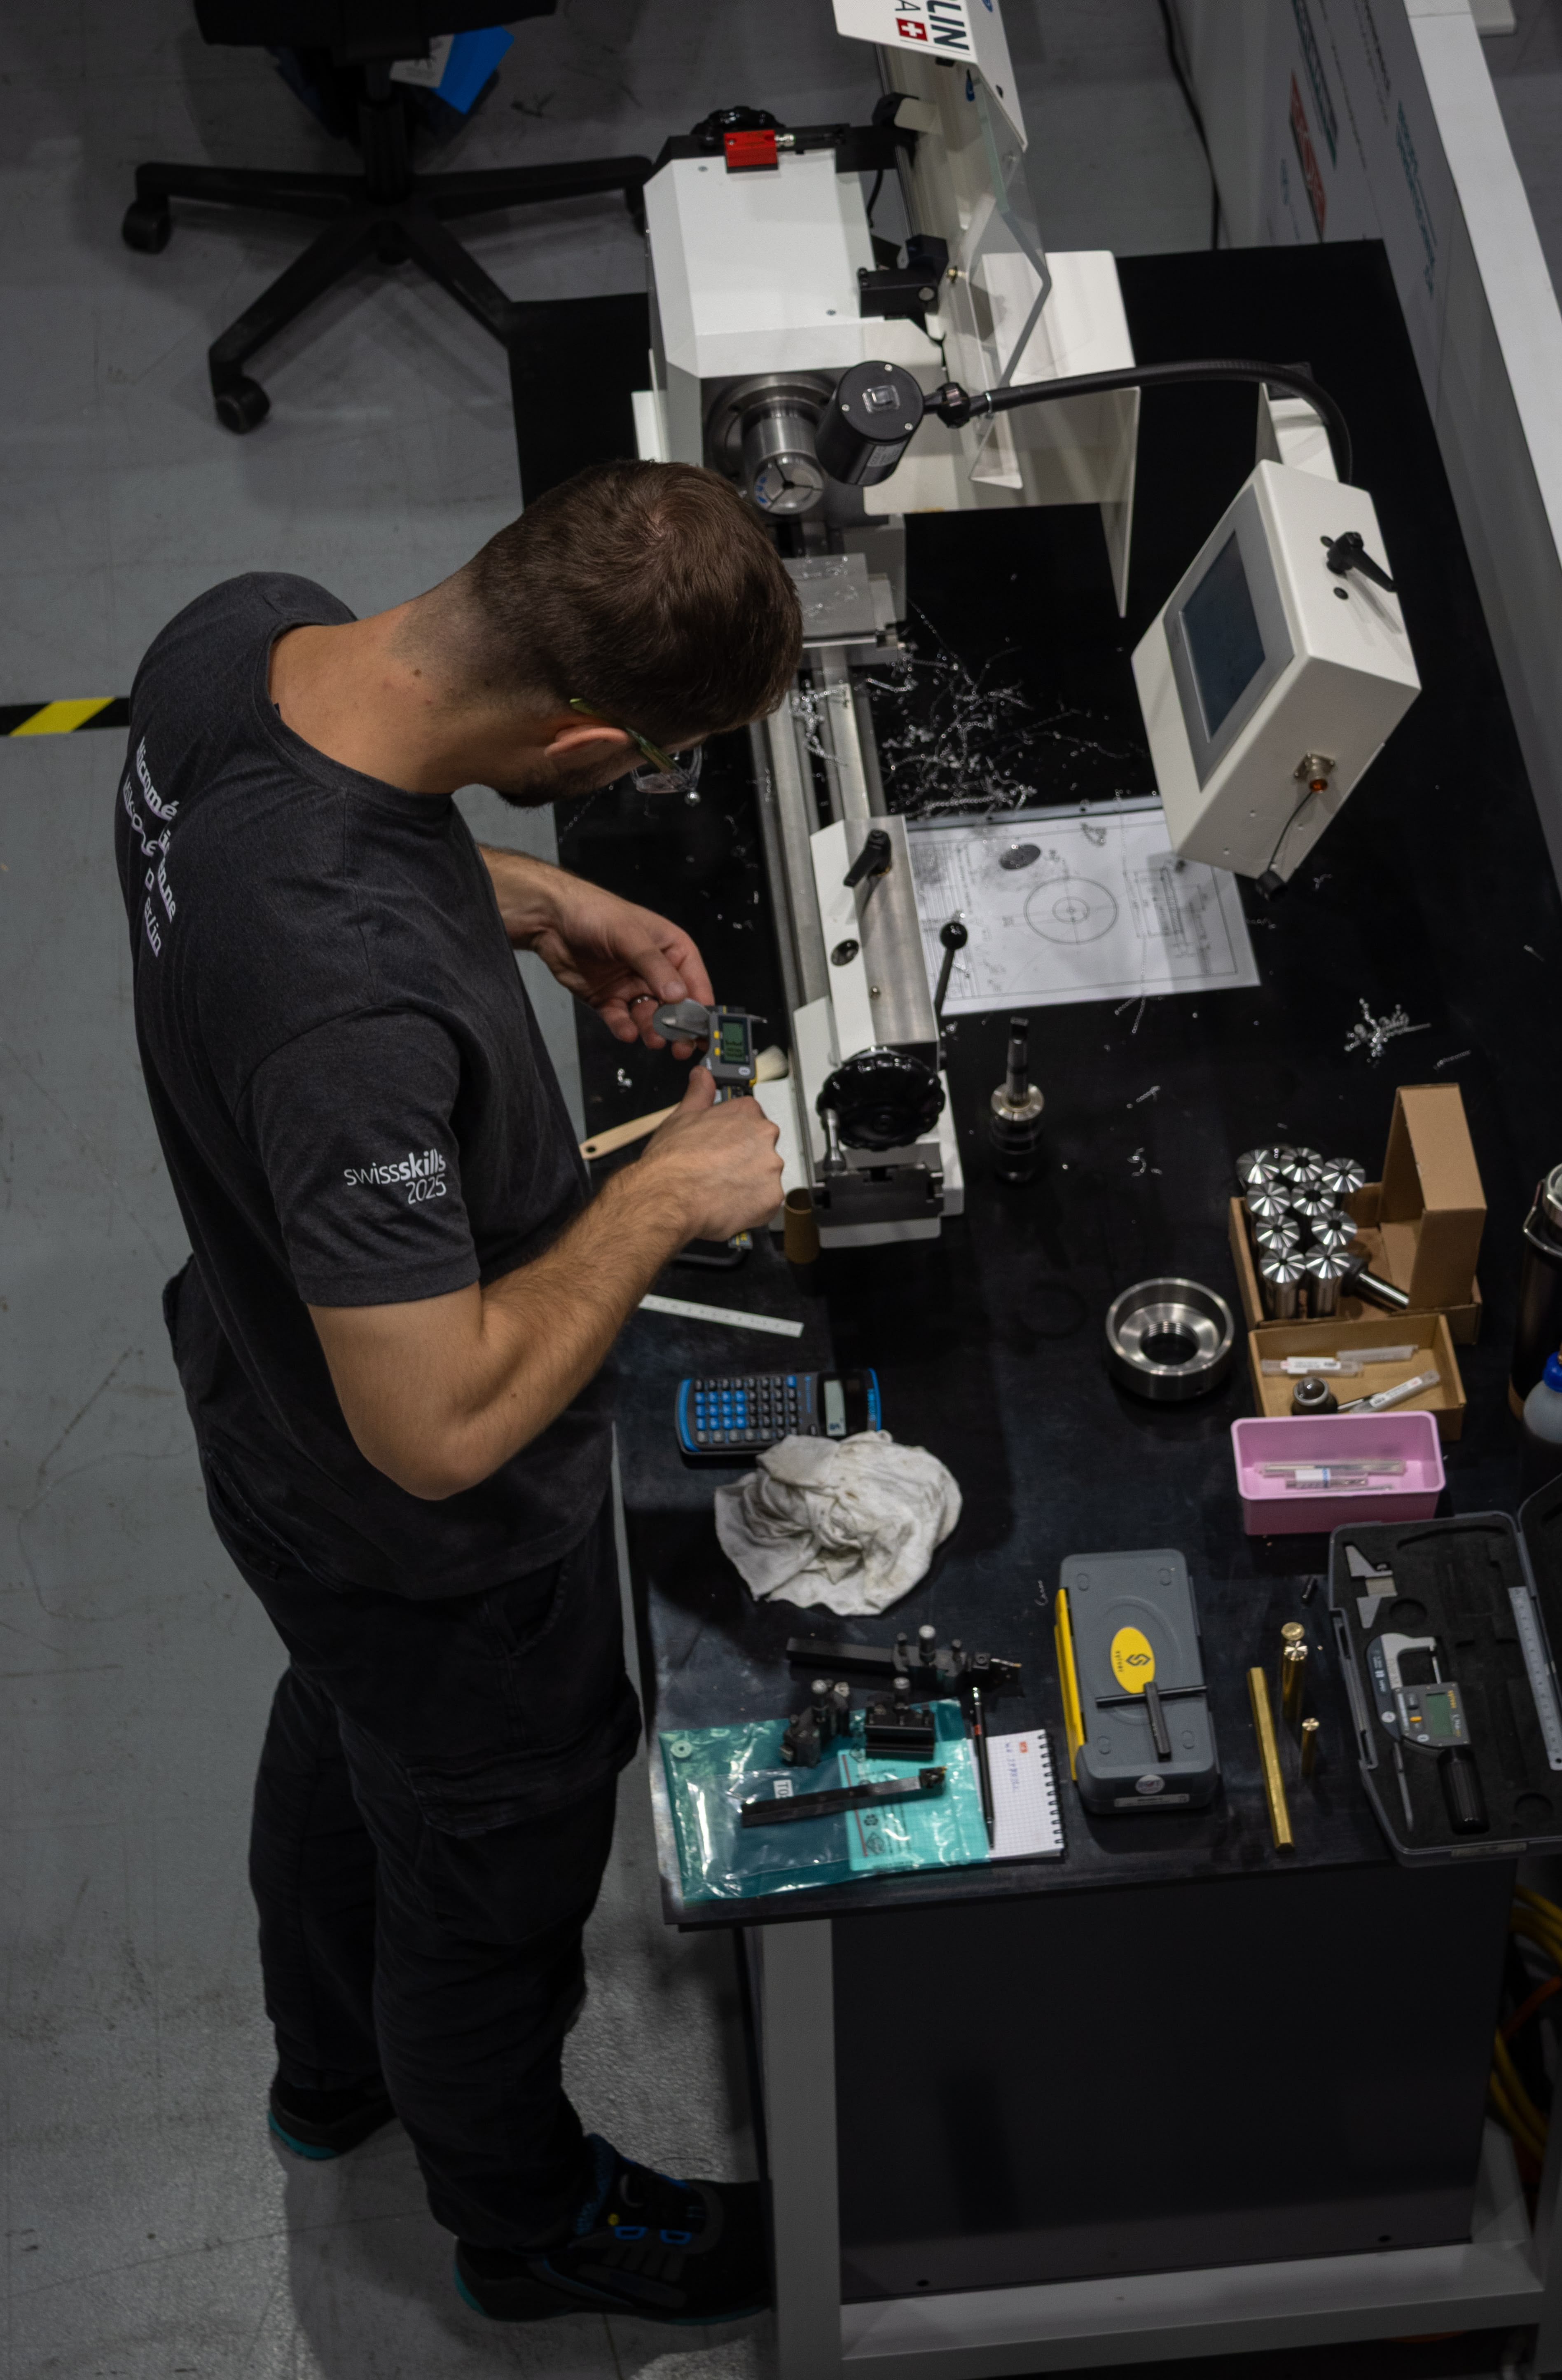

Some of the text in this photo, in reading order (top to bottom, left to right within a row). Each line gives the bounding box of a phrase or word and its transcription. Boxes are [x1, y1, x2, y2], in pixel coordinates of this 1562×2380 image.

[927, 0, 969, 50] LIN
[344, 1148, 446, 1186] swissskills
[406, 1173, 447, 1204] 2025
